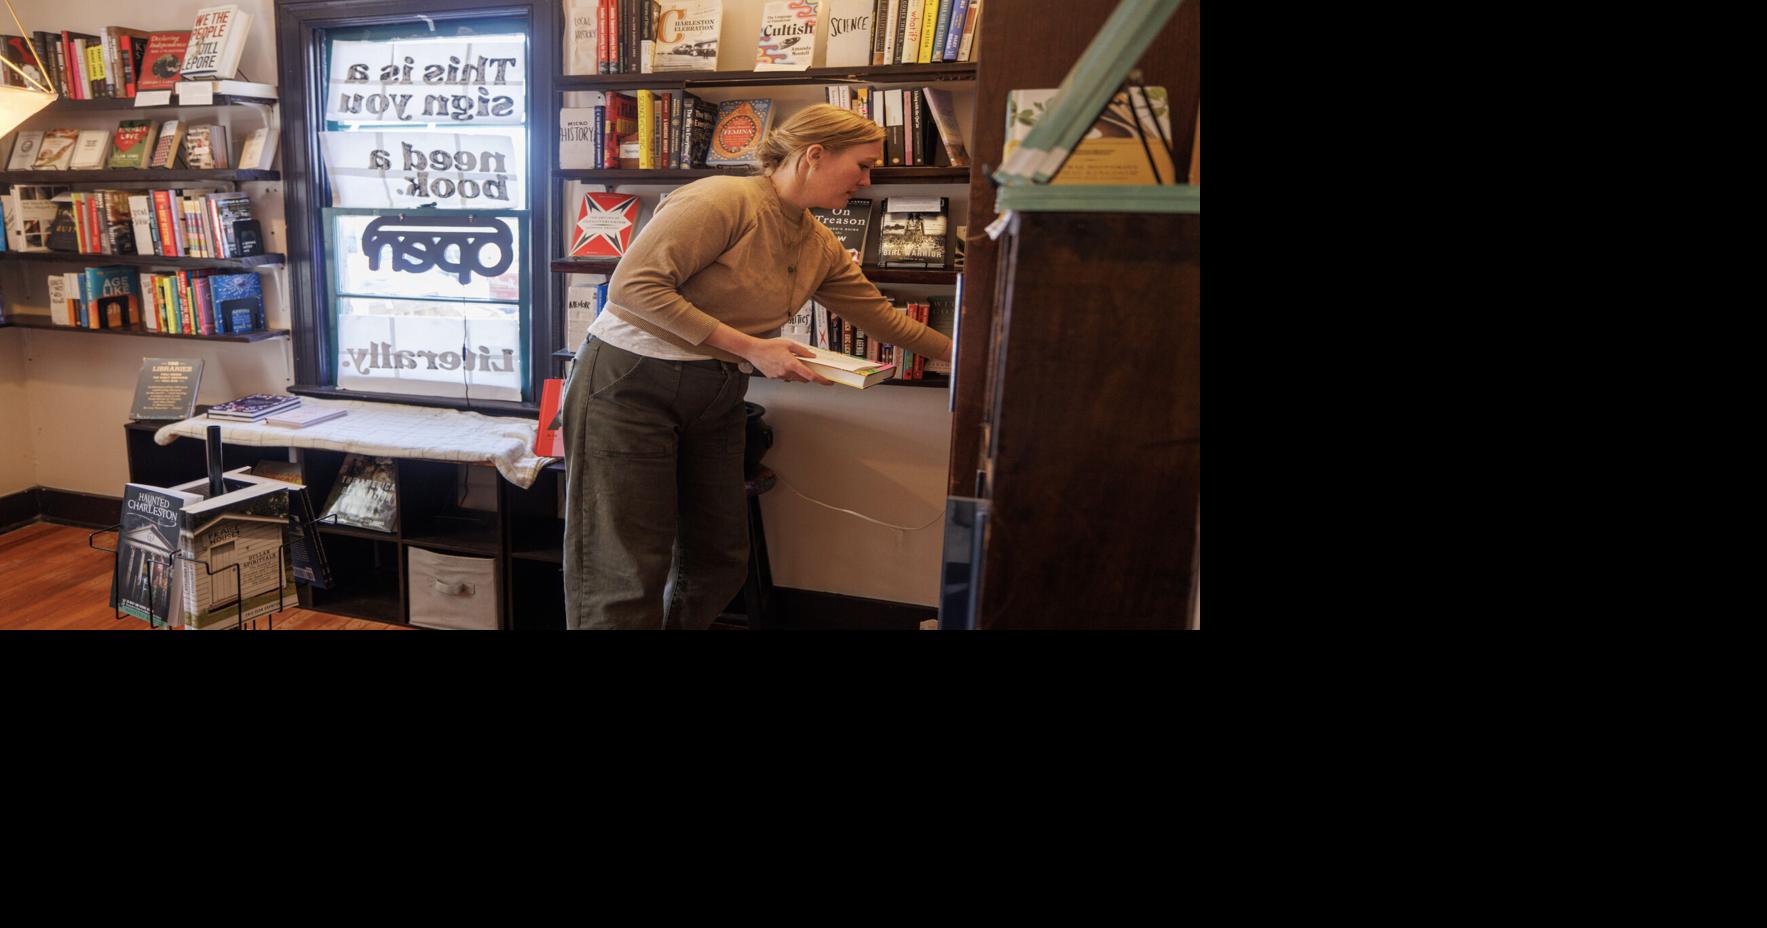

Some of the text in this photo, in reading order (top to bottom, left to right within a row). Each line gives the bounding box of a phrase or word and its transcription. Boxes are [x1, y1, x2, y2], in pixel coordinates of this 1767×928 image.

[195, 10, 230, 26] WE THE
[910, 11, 919, 30] what
[192, 25, 226, 40] PEOPLE
[764, 22, 814, 37] Cultish
[831, 16, 869, 37] SCIENCE
[560, 126, 594, 142] HISTORY
[815, 215, 866, 225] Treason
[104, 276, 128, 288] AGE
[138, 492, 170, 508] HAUNTED
[128, 500, 178, 521] CHARLESTON
